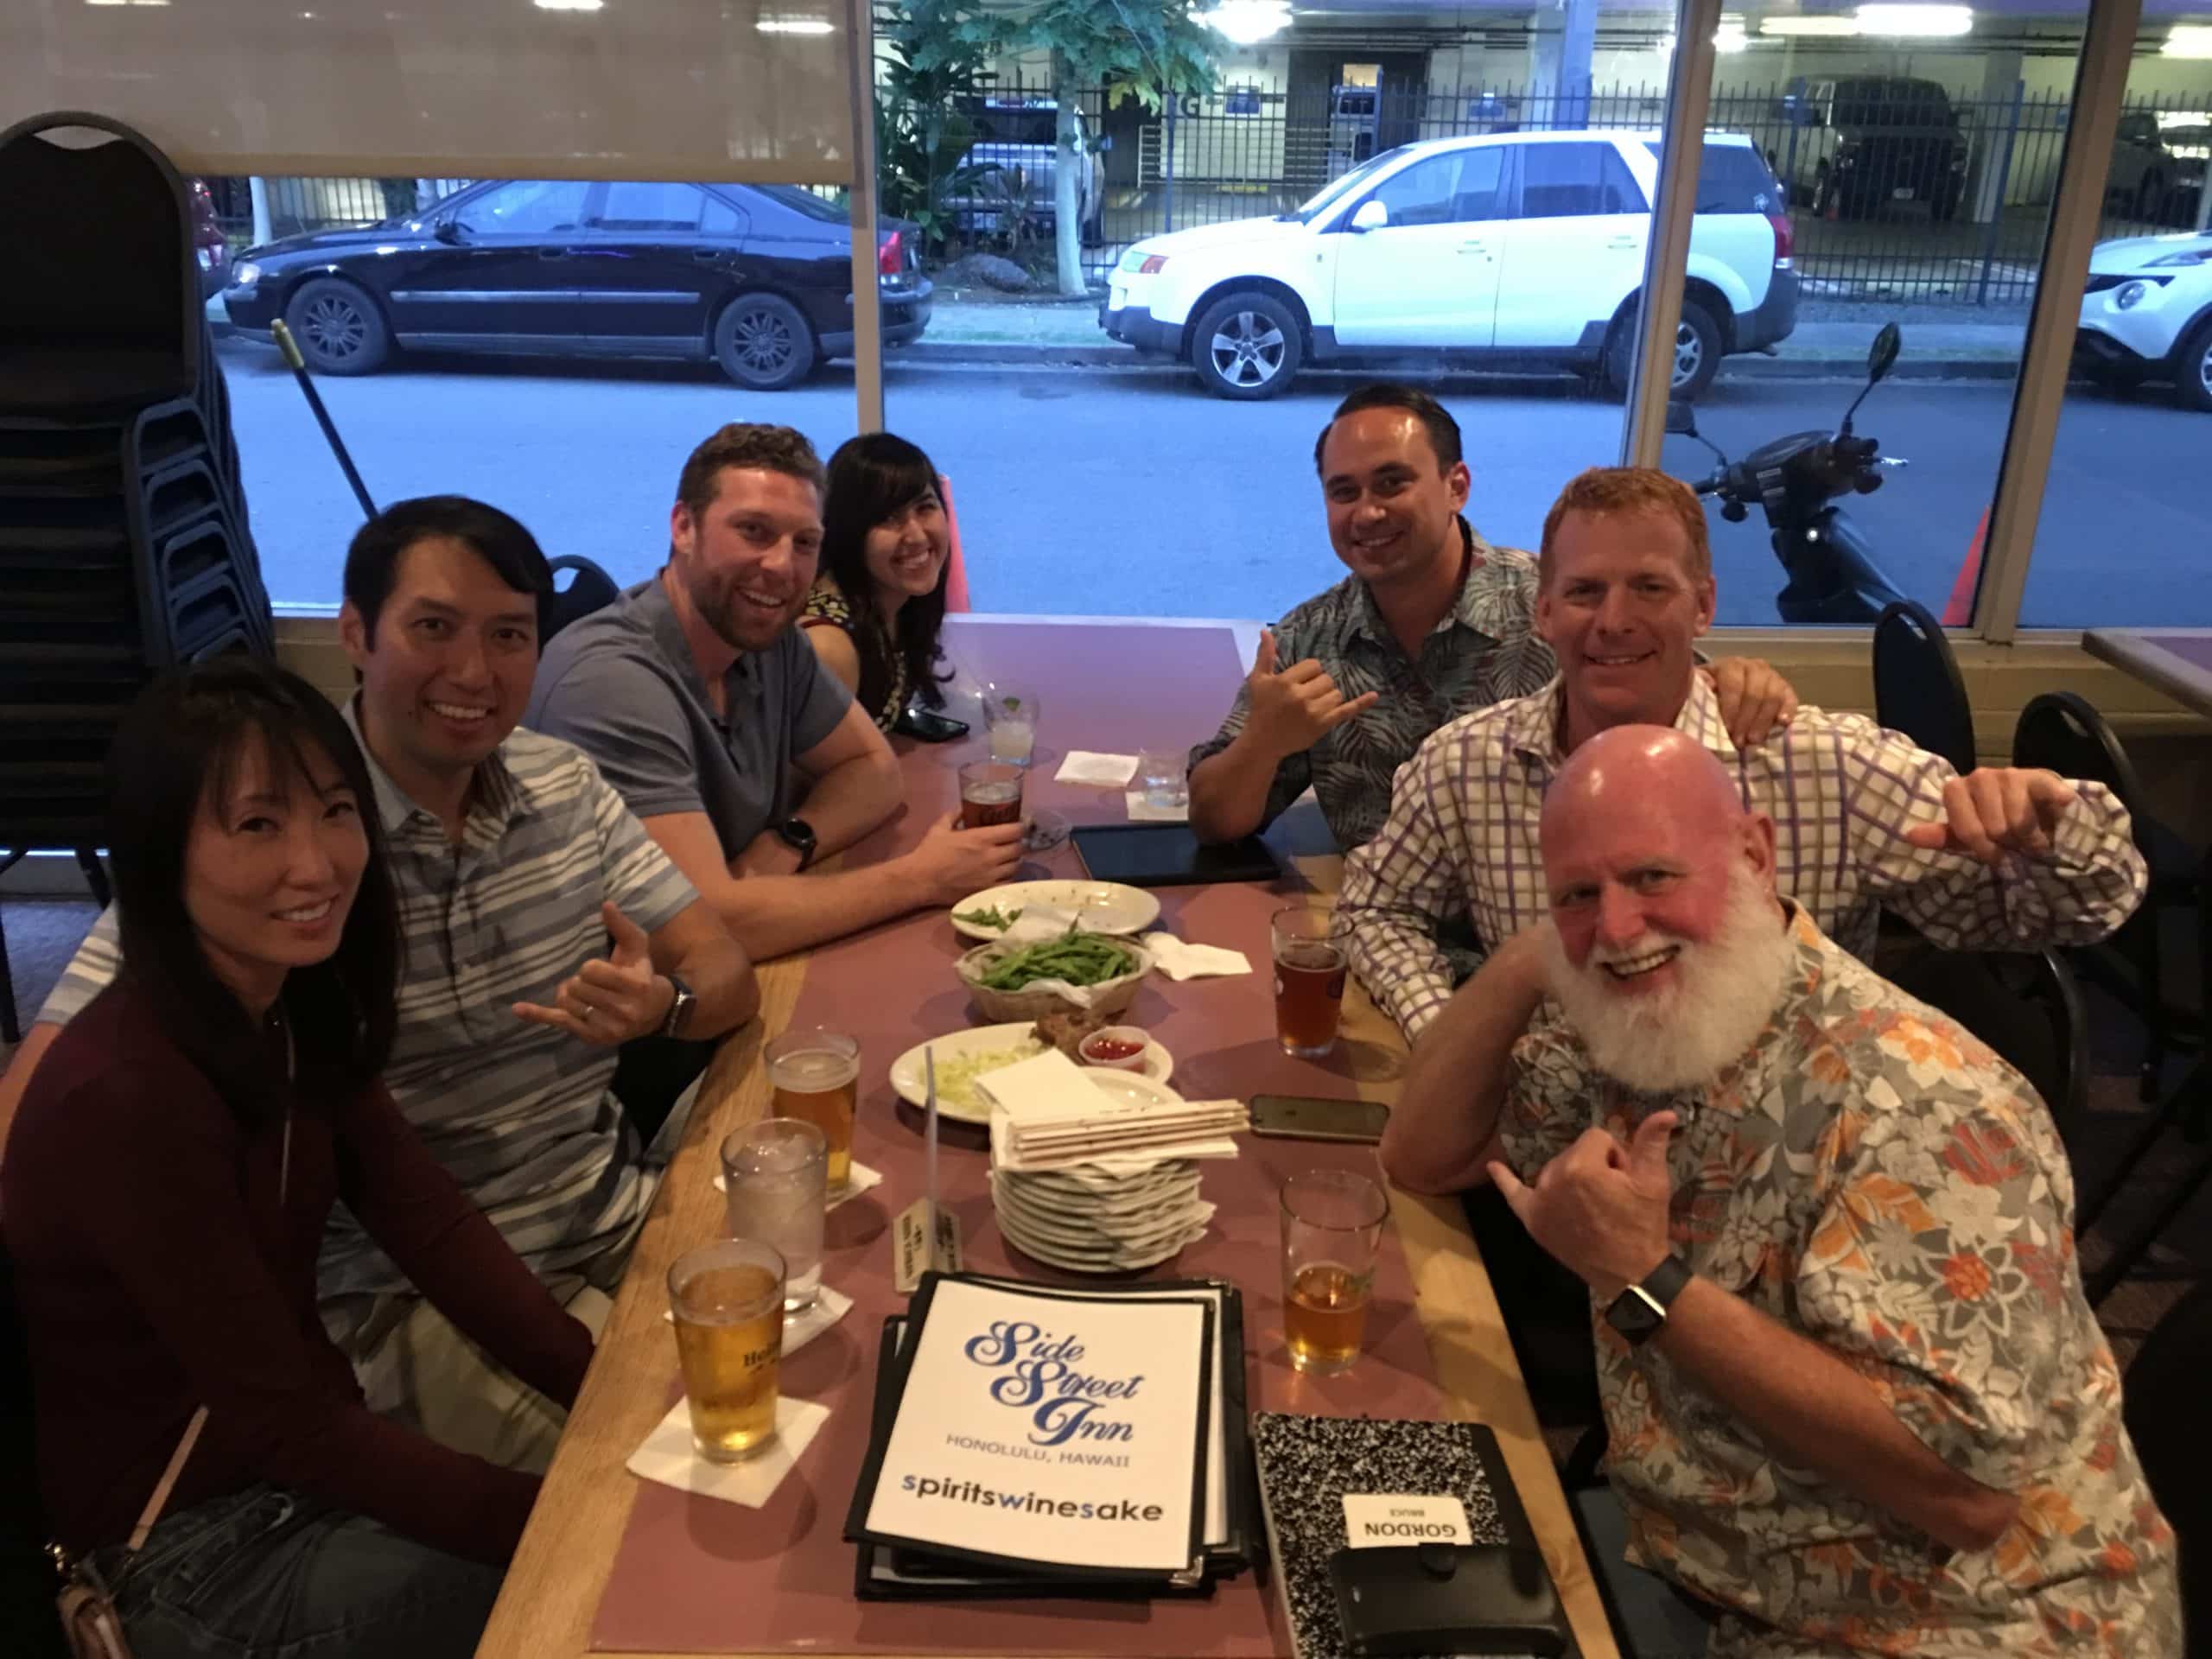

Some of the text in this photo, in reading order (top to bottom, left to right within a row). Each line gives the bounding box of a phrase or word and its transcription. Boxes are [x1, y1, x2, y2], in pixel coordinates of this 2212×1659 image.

[964, 1320, 1085, 1367] Side
[989, 1358, 1145, 1408] Street
[1027, 1396, 1134, 1446] Inn
[946, 1433, 1130, 1468] HONOLULU, HAWAII
[1364, 1522, 1457, 1538] GORDON
[1389, 1508, 1425, 1517] BRUCE
